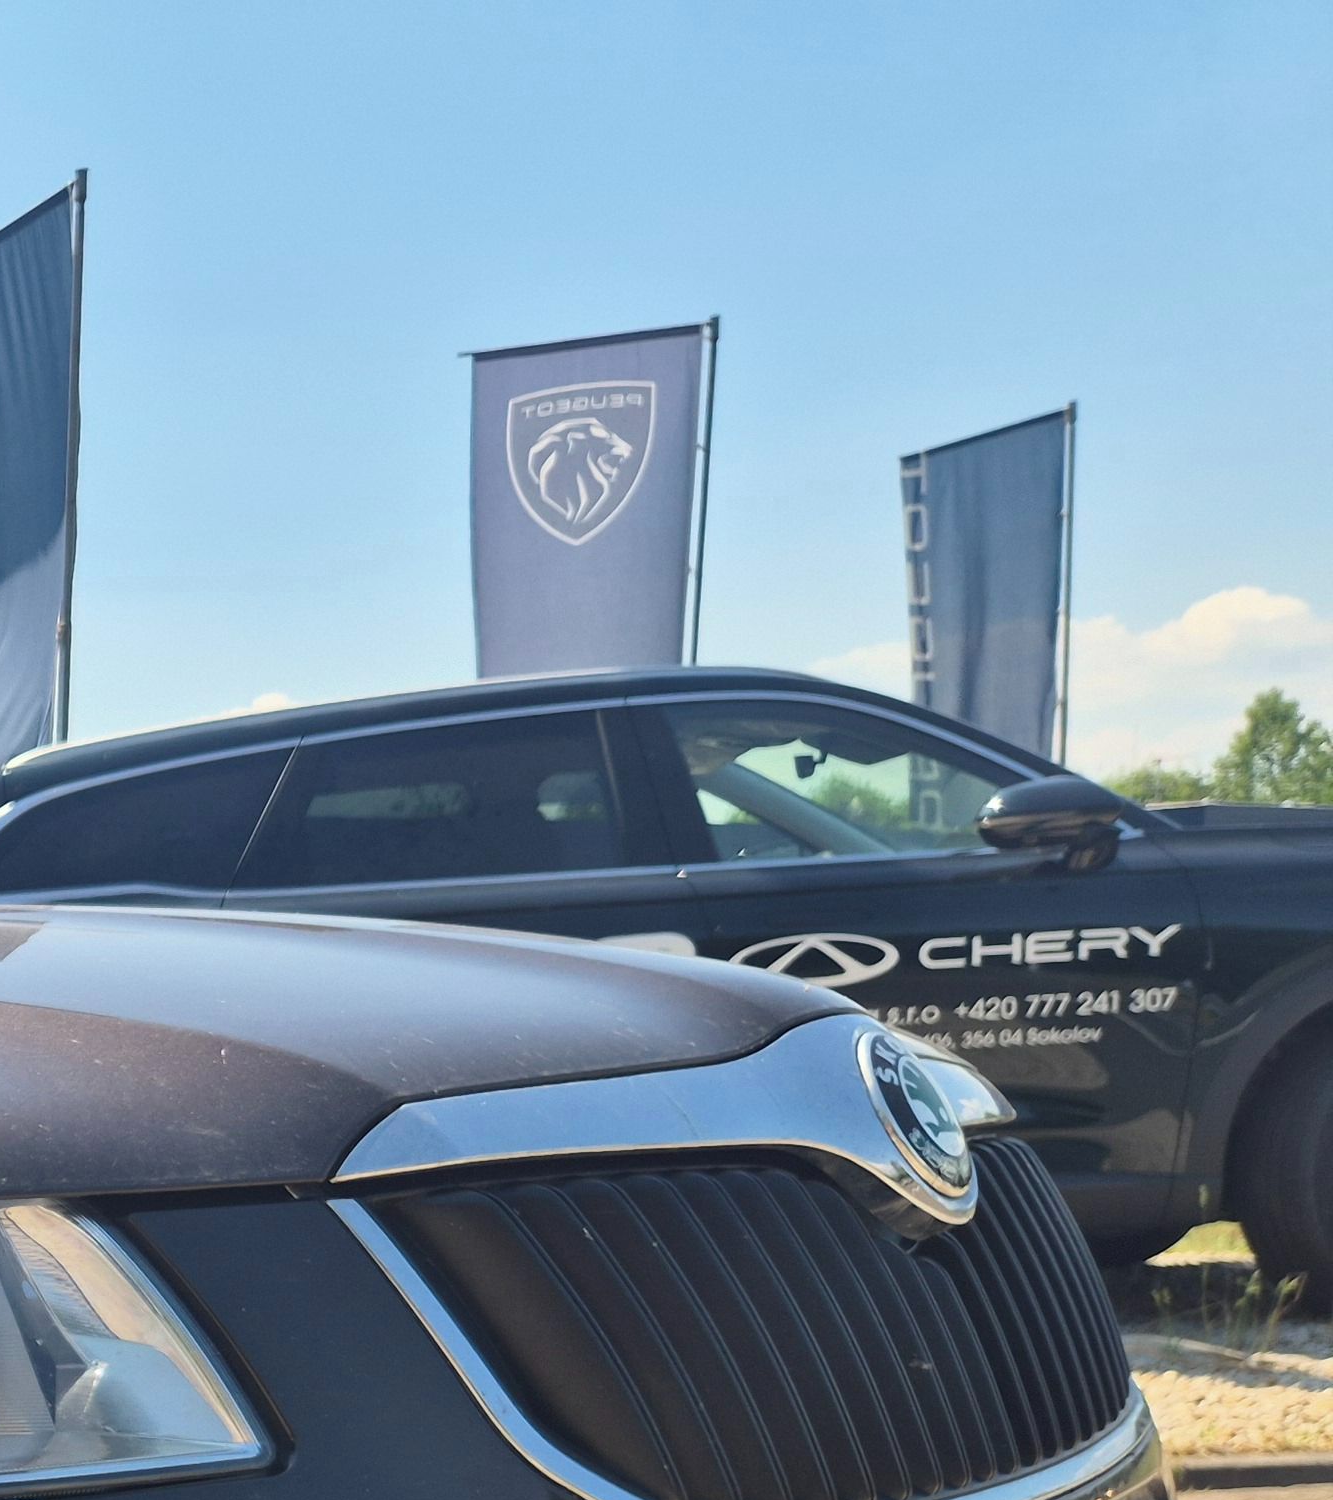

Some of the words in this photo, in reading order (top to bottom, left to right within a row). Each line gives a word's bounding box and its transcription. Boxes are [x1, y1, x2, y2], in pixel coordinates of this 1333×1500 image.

[918, 923, 1182, 970] CHERY
[954, 995, 1018, 1021] +420
[1025, 992, 1072, 1018] 777
[1077, 989, 1121, 1016] 241
[1129, 986, 1178, 1013] 307
[961, 1030, 997, 1049] 356
[999, 1027, 1023, 1047] 04
[1025, 1025, 1104, 1046] Sokolov
